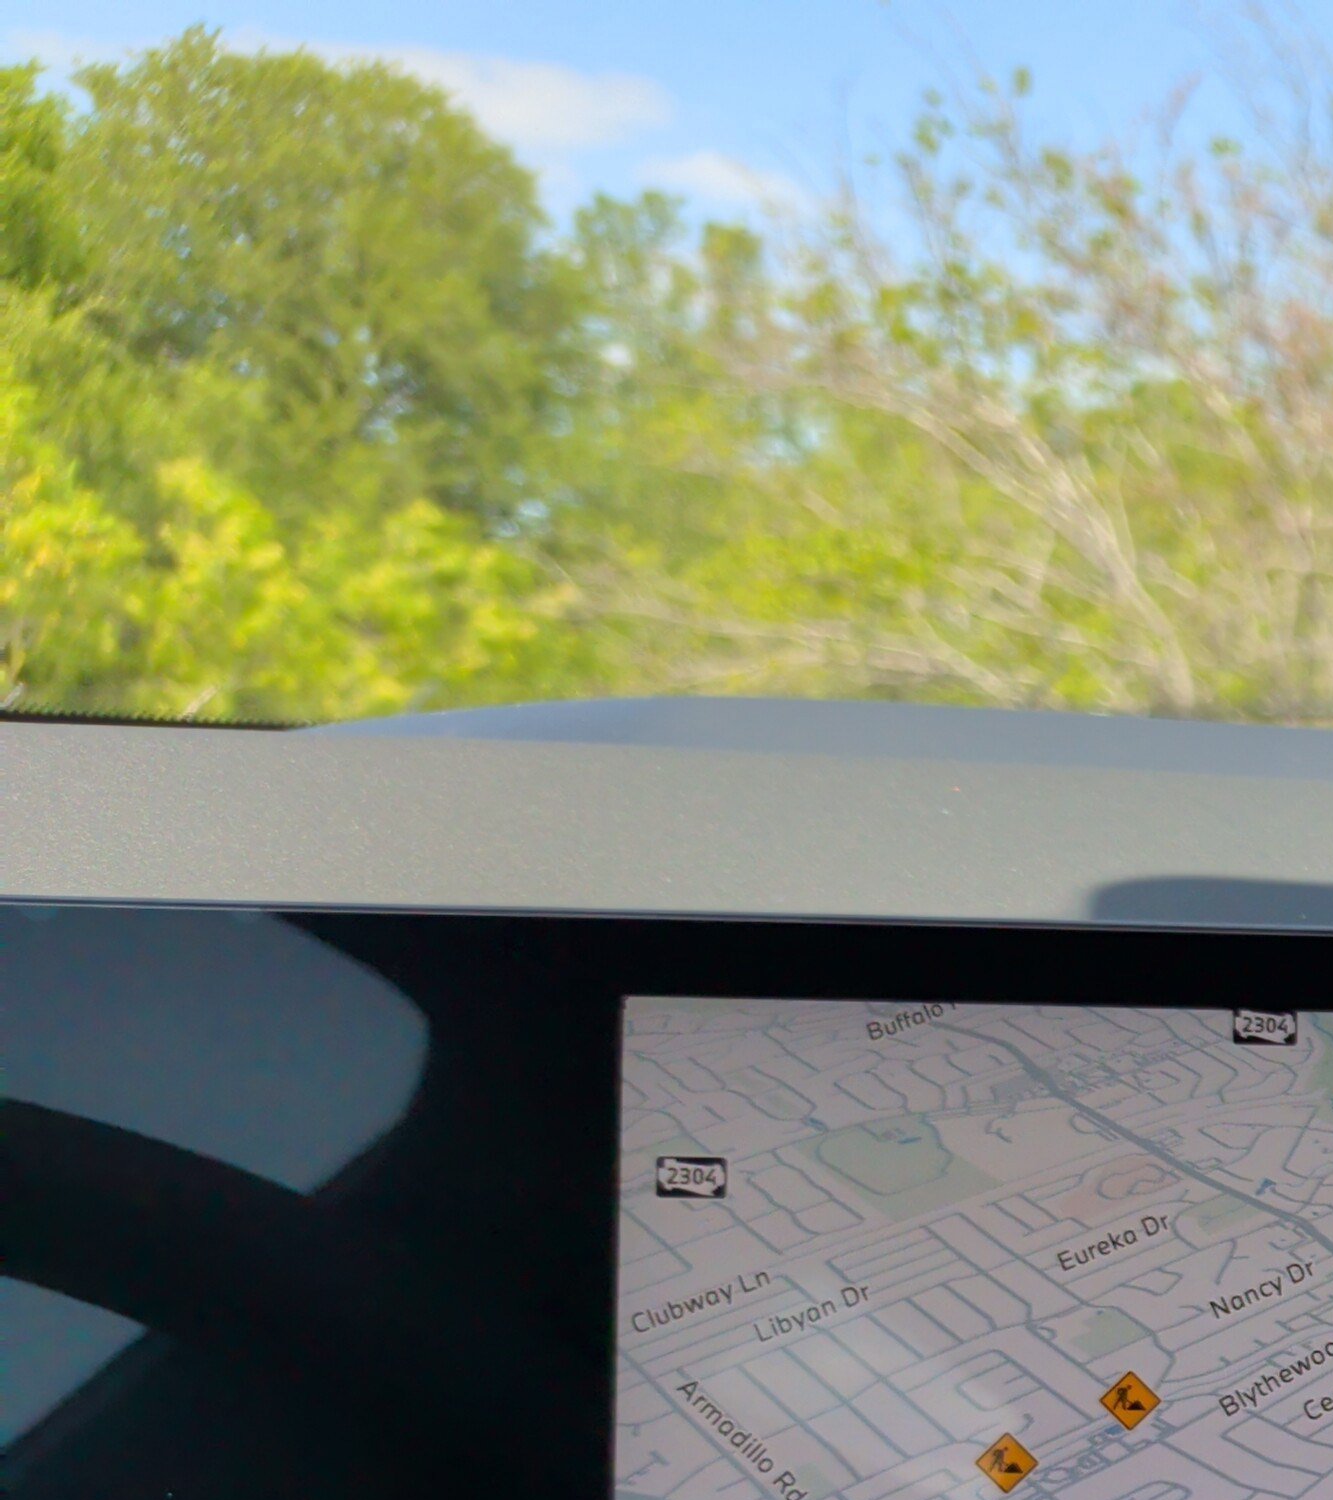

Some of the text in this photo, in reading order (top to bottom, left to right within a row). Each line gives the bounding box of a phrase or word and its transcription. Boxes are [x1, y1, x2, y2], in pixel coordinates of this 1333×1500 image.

[866, 1003, 944, 1041] Buffalo
[1241, 1016, 1289, 1036] 2304
[666, 1167, 719, 1187] 2304
[1056, 1212, 1171, 1272] Eureka Dr
[630, 1267, 772, 1335] Clubway Ln
[752, 1281, 872, 1343] Libyan Dr
[1209, 1258, 1315, 1321] Nancy Dr
[676, 1378, 775, 1474] Armadillo
